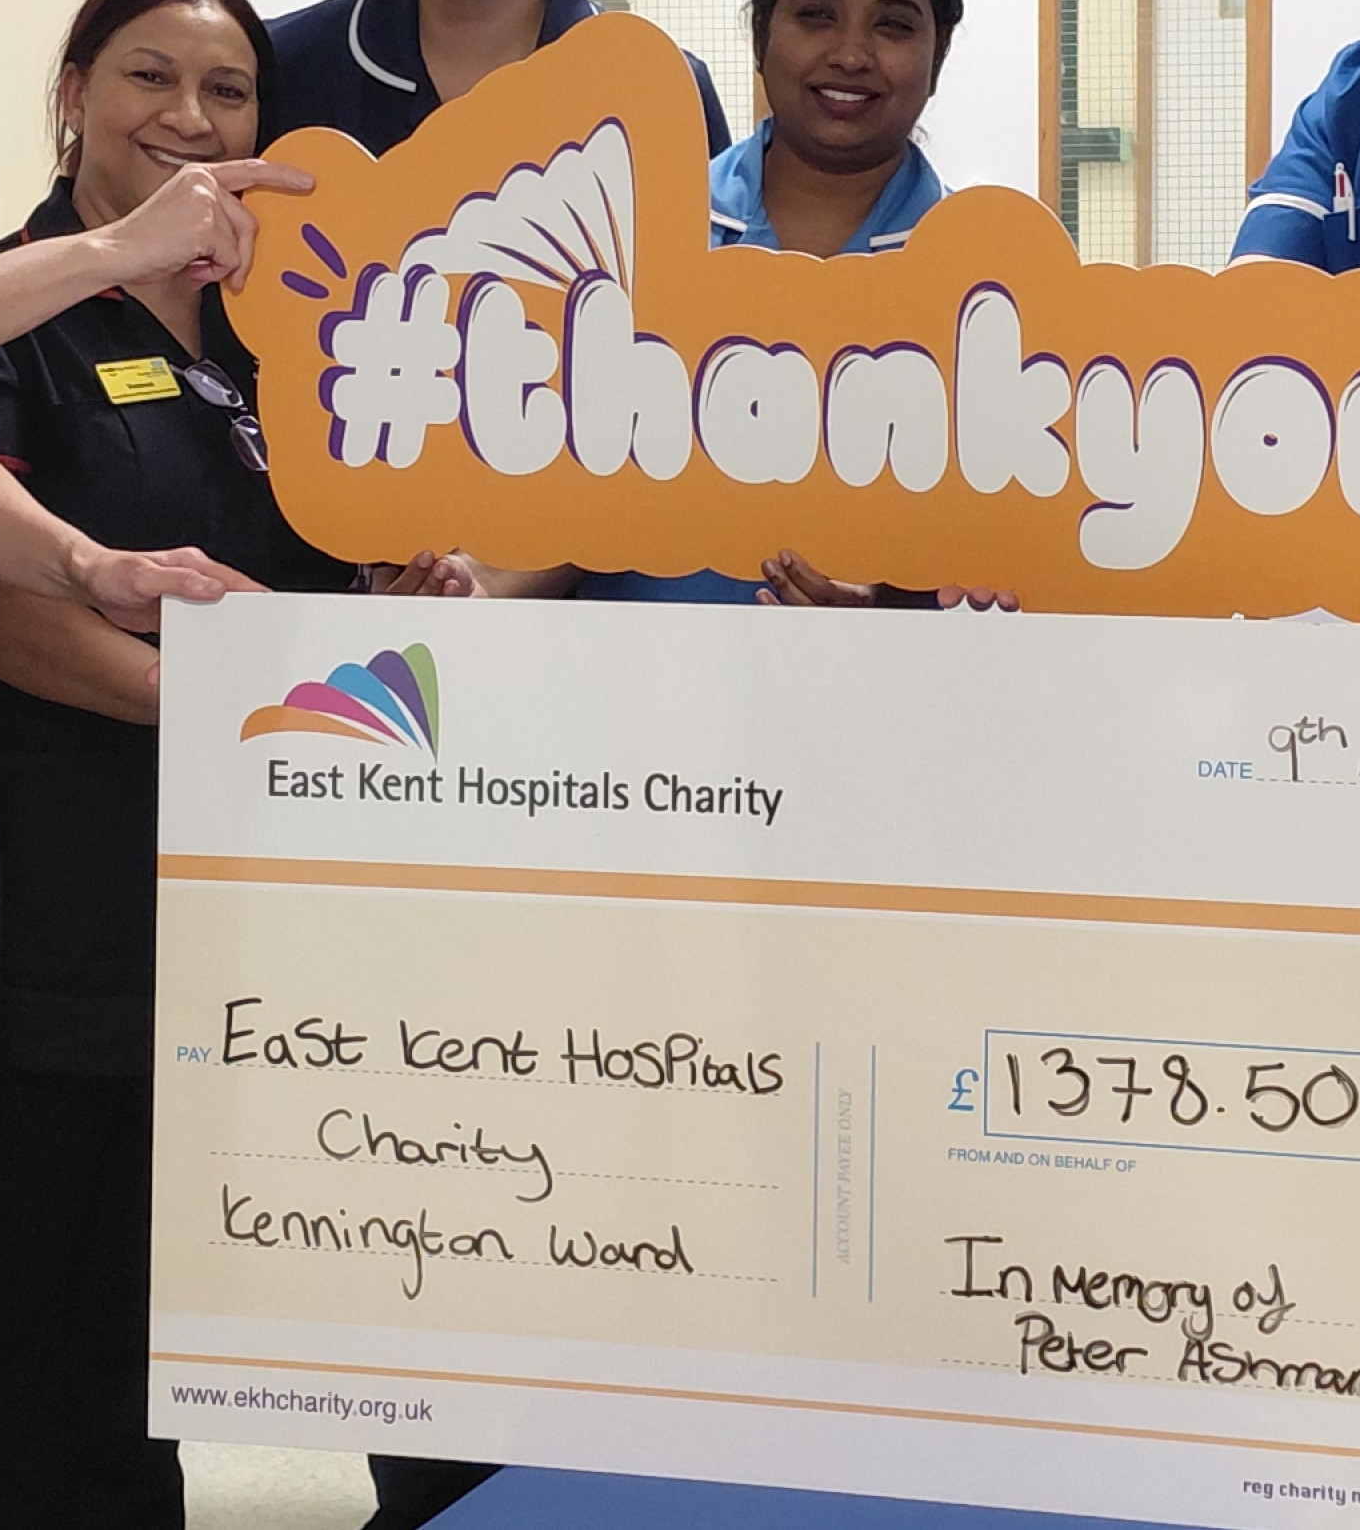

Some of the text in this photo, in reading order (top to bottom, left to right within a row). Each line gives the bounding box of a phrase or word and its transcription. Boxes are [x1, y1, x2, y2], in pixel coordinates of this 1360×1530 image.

[1198, 760, 1253, 780] DATE
[1268, 715, 1349, 782] 9th
[268, 759, 784, 827] East Kent Hospitals Charity
[176, 1046, 212, 1063] PAY
[947, 1068, 980, 1112] £
[1007, 1047, 1359, 1132] 1378.50
[317, 1108, 553, 1203] Charity
[836, 1087, 852, 1265] ACCOUNT PAYEE ONLY
[947, 1147, 1137, 1172] FROM AND ON BEHALF OF
[944, 1235, 1297, 1342] In Memory of
[1014, 1310, 1149, 1375] Peter
[171, 1384, 433, 1425] www.ekhcharity.org.uk
[1243, 1480, 1274, 1500] reg
[1279, 1482, 1346, 1506] charity
